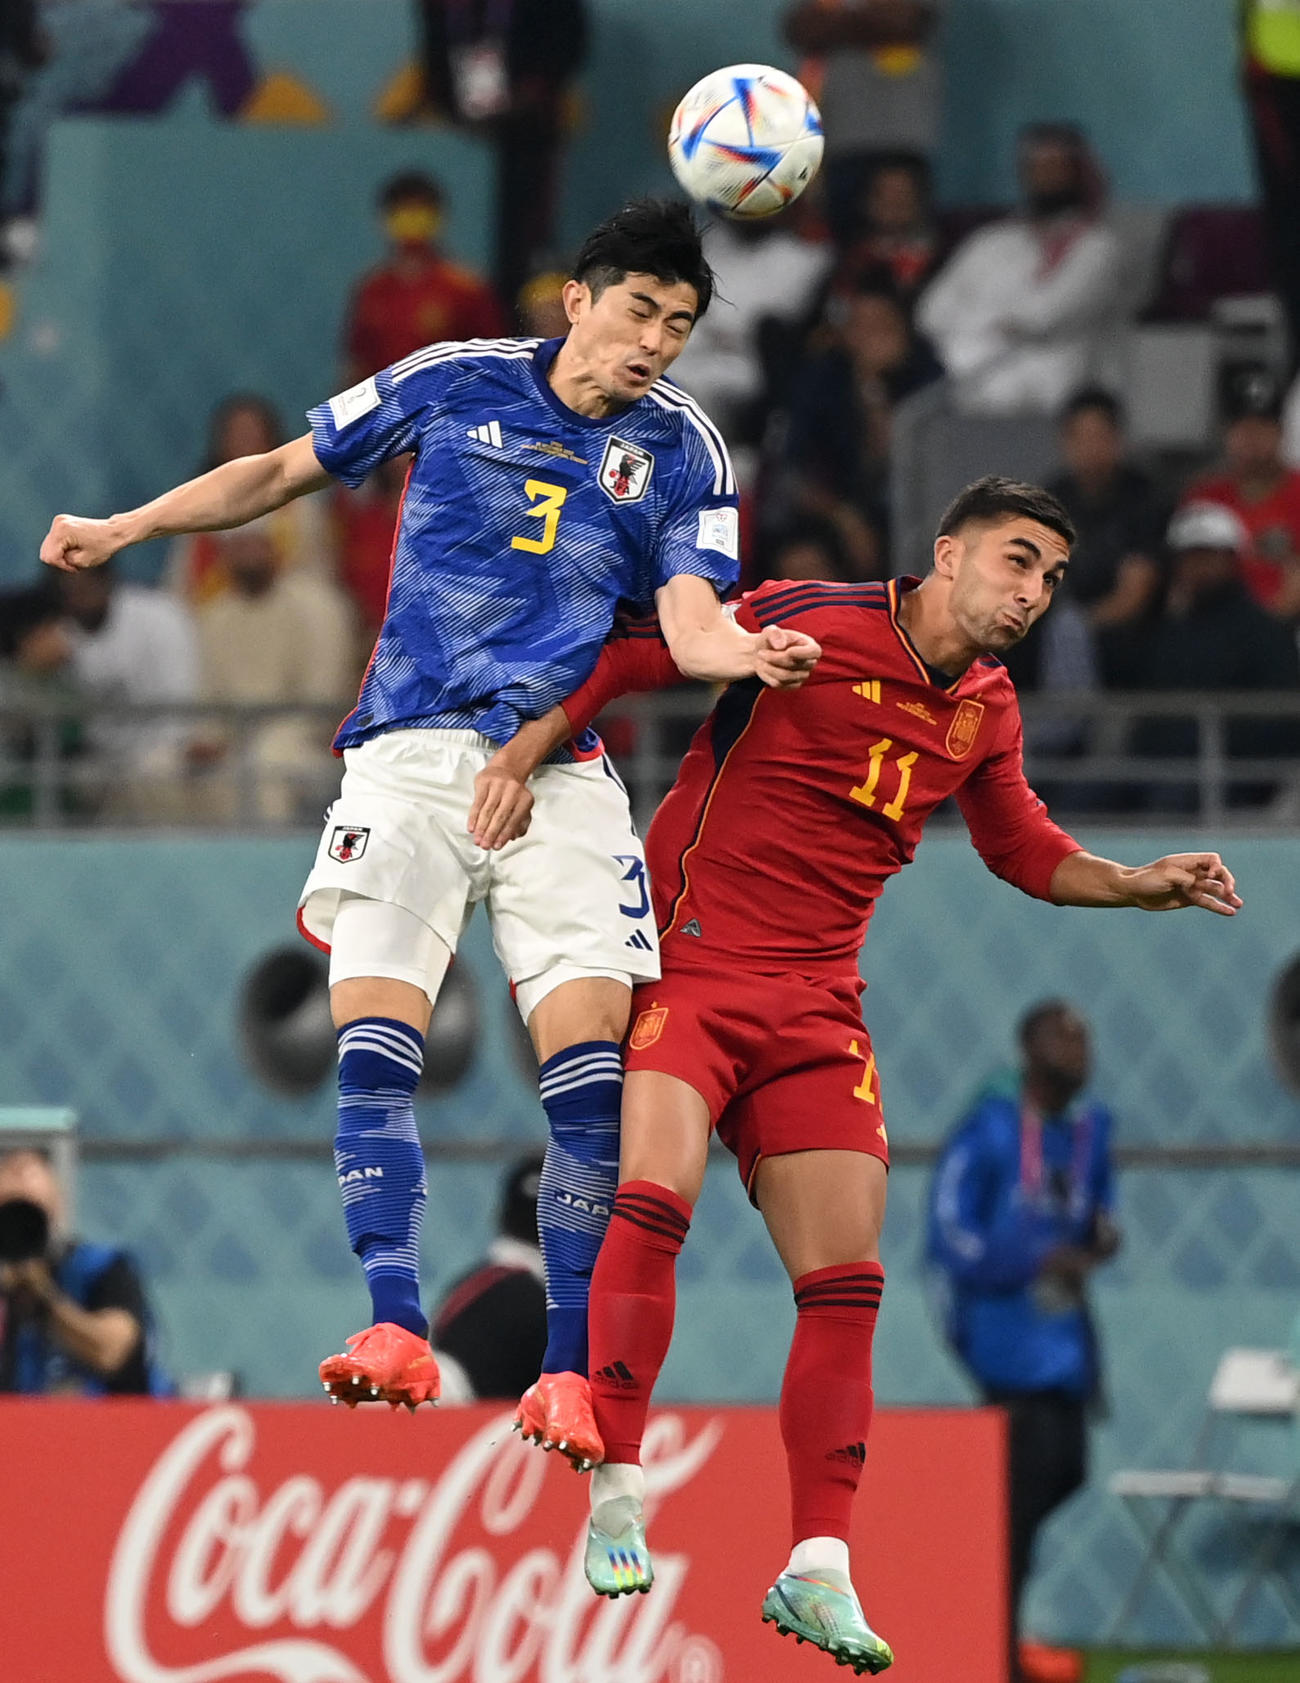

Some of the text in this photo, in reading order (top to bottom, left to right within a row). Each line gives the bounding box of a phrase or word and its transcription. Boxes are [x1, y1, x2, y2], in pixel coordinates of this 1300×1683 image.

[511, 479, 567, 555] 3
[849, 738, 919, 822] 11
[610, 855, 650, 919] 3
[848, 1039, 882, 1112] 1
[338, 1167, 384, 1188] PAN
[556, 1193, 609, 1215] JAP
